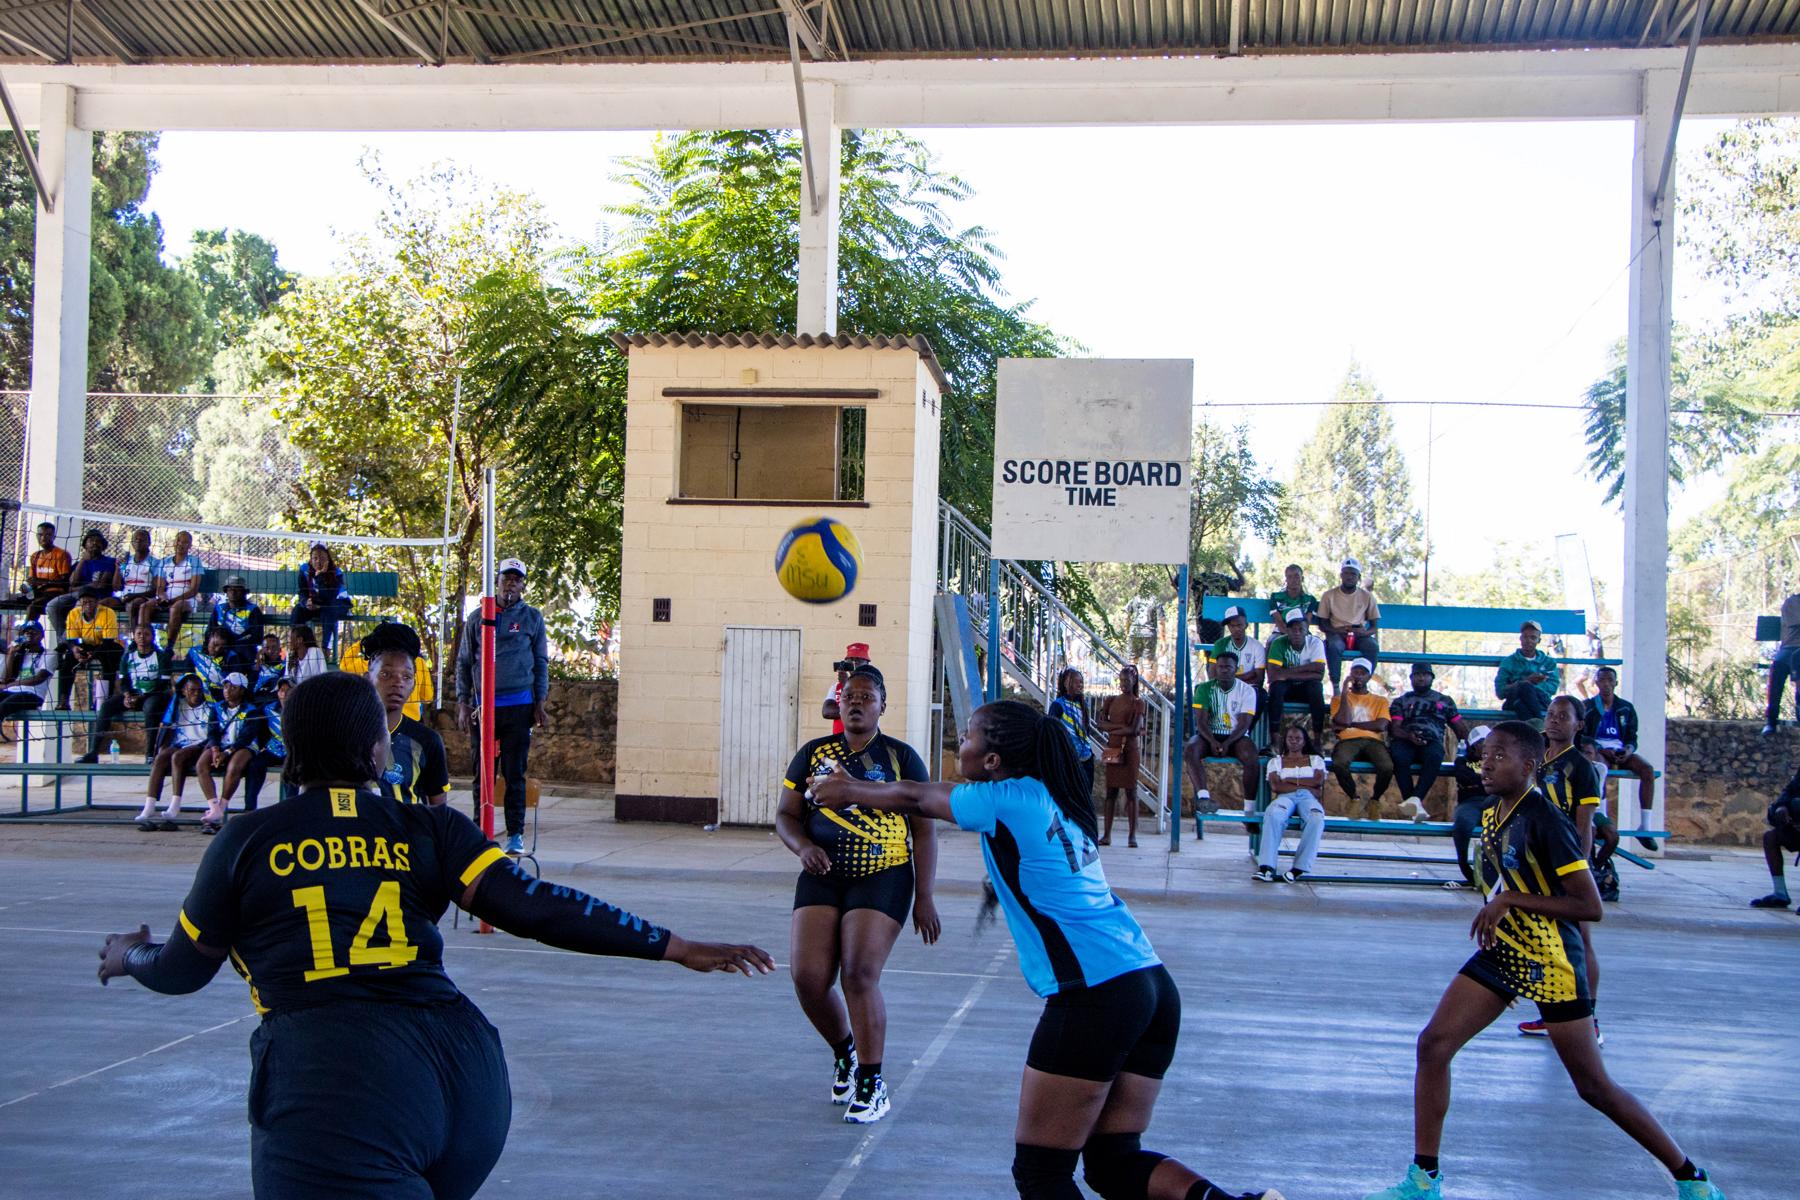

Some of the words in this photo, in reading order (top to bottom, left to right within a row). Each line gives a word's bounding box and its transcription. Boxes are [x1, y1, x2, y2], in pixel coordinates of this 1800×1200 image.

[1002, 459, 1089, 485] SCORE
[1094, 461, 1182, 487] BOARD
[1065, 487, 1117, 507] TIME
[1605, 726, 1618, 736] 10
[337, 792, 352, 812] MSU
[269, 836, 411, 877] COBRAS
[291, 880, 419, 983] 14
